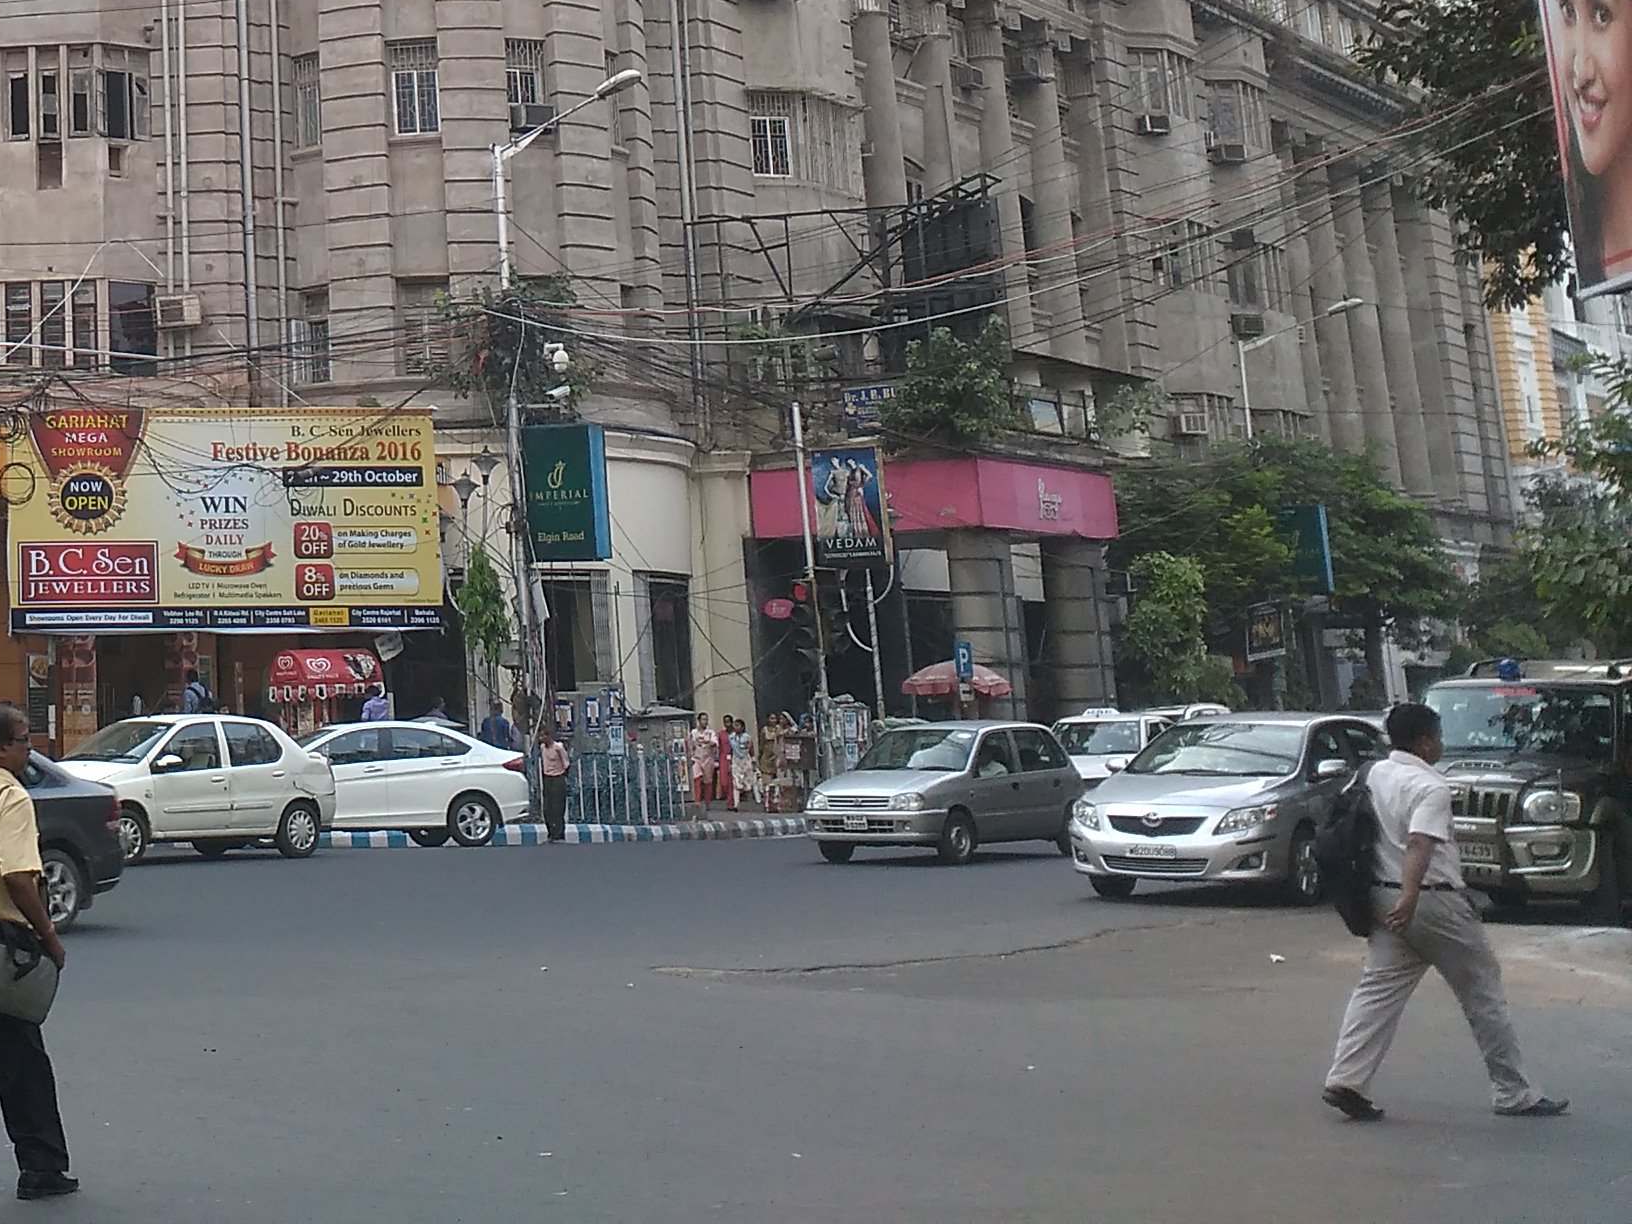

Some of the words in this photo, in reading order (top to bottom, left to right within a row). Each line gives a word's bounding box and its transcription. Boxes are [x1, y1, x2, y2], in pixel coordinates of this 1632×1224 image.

[44, 414, 128, 429] GARIAHAT
[291, 426, 305, 437] B.
[309, 426, 325, 437] C.
[329, 426, 354, 437] Sen
[359, 425, 422, 437] Jewellers
[65, 432, 108, 444] MEGA
[51, 447, 122, 457] SHOWROOM
[211, 441, 280, 462] Festive
[284, 441, 370, 462] Bonanza
[376, 441, 423, 461] 2016
[332, 470, 362, 483] 29th
[365, 470, 418, 483] October
[70, 481, 103, 492] NOW
[529, 489, 589, 501] IMPERIAL
[65, 496, 109, 511] OPEN
[200, 496, 248, 514] WIN
[342, 498, 417, 516] DISCOUNTS
[200, 518, 249, 530] PRIZES
[205, 534, 244, 545] DAILY
[349, 530, 379, 539] Making
[380, 529, 411, 538] Charges
[537, 532, 560, 543] Elgin
[562, 531, 585, 541] Road
[301, 542, 328, 555] OFF
[368, 541, 404, 550] Jewellery
[826, 537, 877, 549] VEDAM
[92, 547, 150, 575] Sen
[198, 562, 227, 574] LUCKY
[229, 562, 255, 573] DRAW
[28, 580, 151, 598] JEWELLERS
[303, 584, 330, 596] OFF
[339, 582, 371, 591] precious
[66, 614, 83, 622] Open
[85, 614, 102, 622] Every
[104, 614, 117, 622] Day
[958, 647, 968, 672] P
